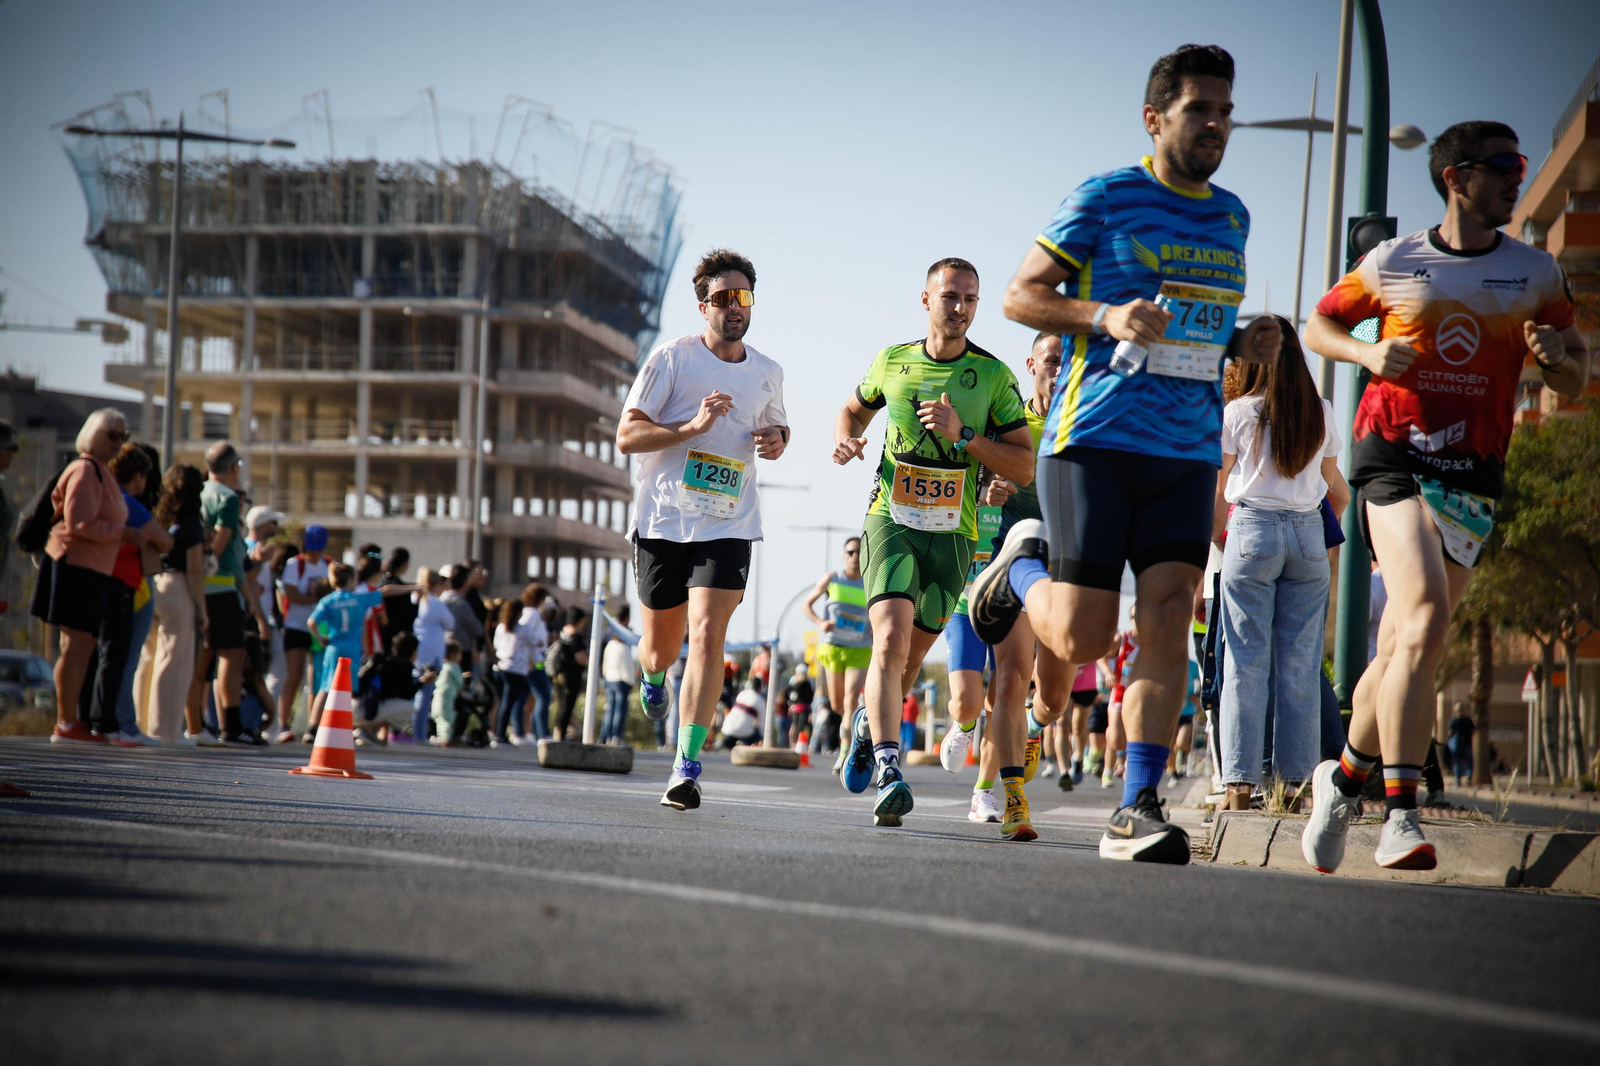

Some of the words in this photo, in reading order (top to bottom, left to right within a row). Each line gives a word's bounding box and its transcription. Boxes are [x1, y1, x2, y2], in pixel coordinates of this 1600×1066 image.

[1160, 244, 1236, 267] BREAKING
[1188, 267, 1212, 277] NEVER
[1213, 269, 1228, 279] RUN
[1177, 300, 1224, 332] 749
[1417, 381, 1463, 395] SALINAS
[1464, 385, 1486, 396] CAR
[1407, 450, 1474, 471] ropack
[692, 461, 739, 488] 1298
[901, 475, 957, 499] 1536
[1442, 504, 1464, 520] PABLO
